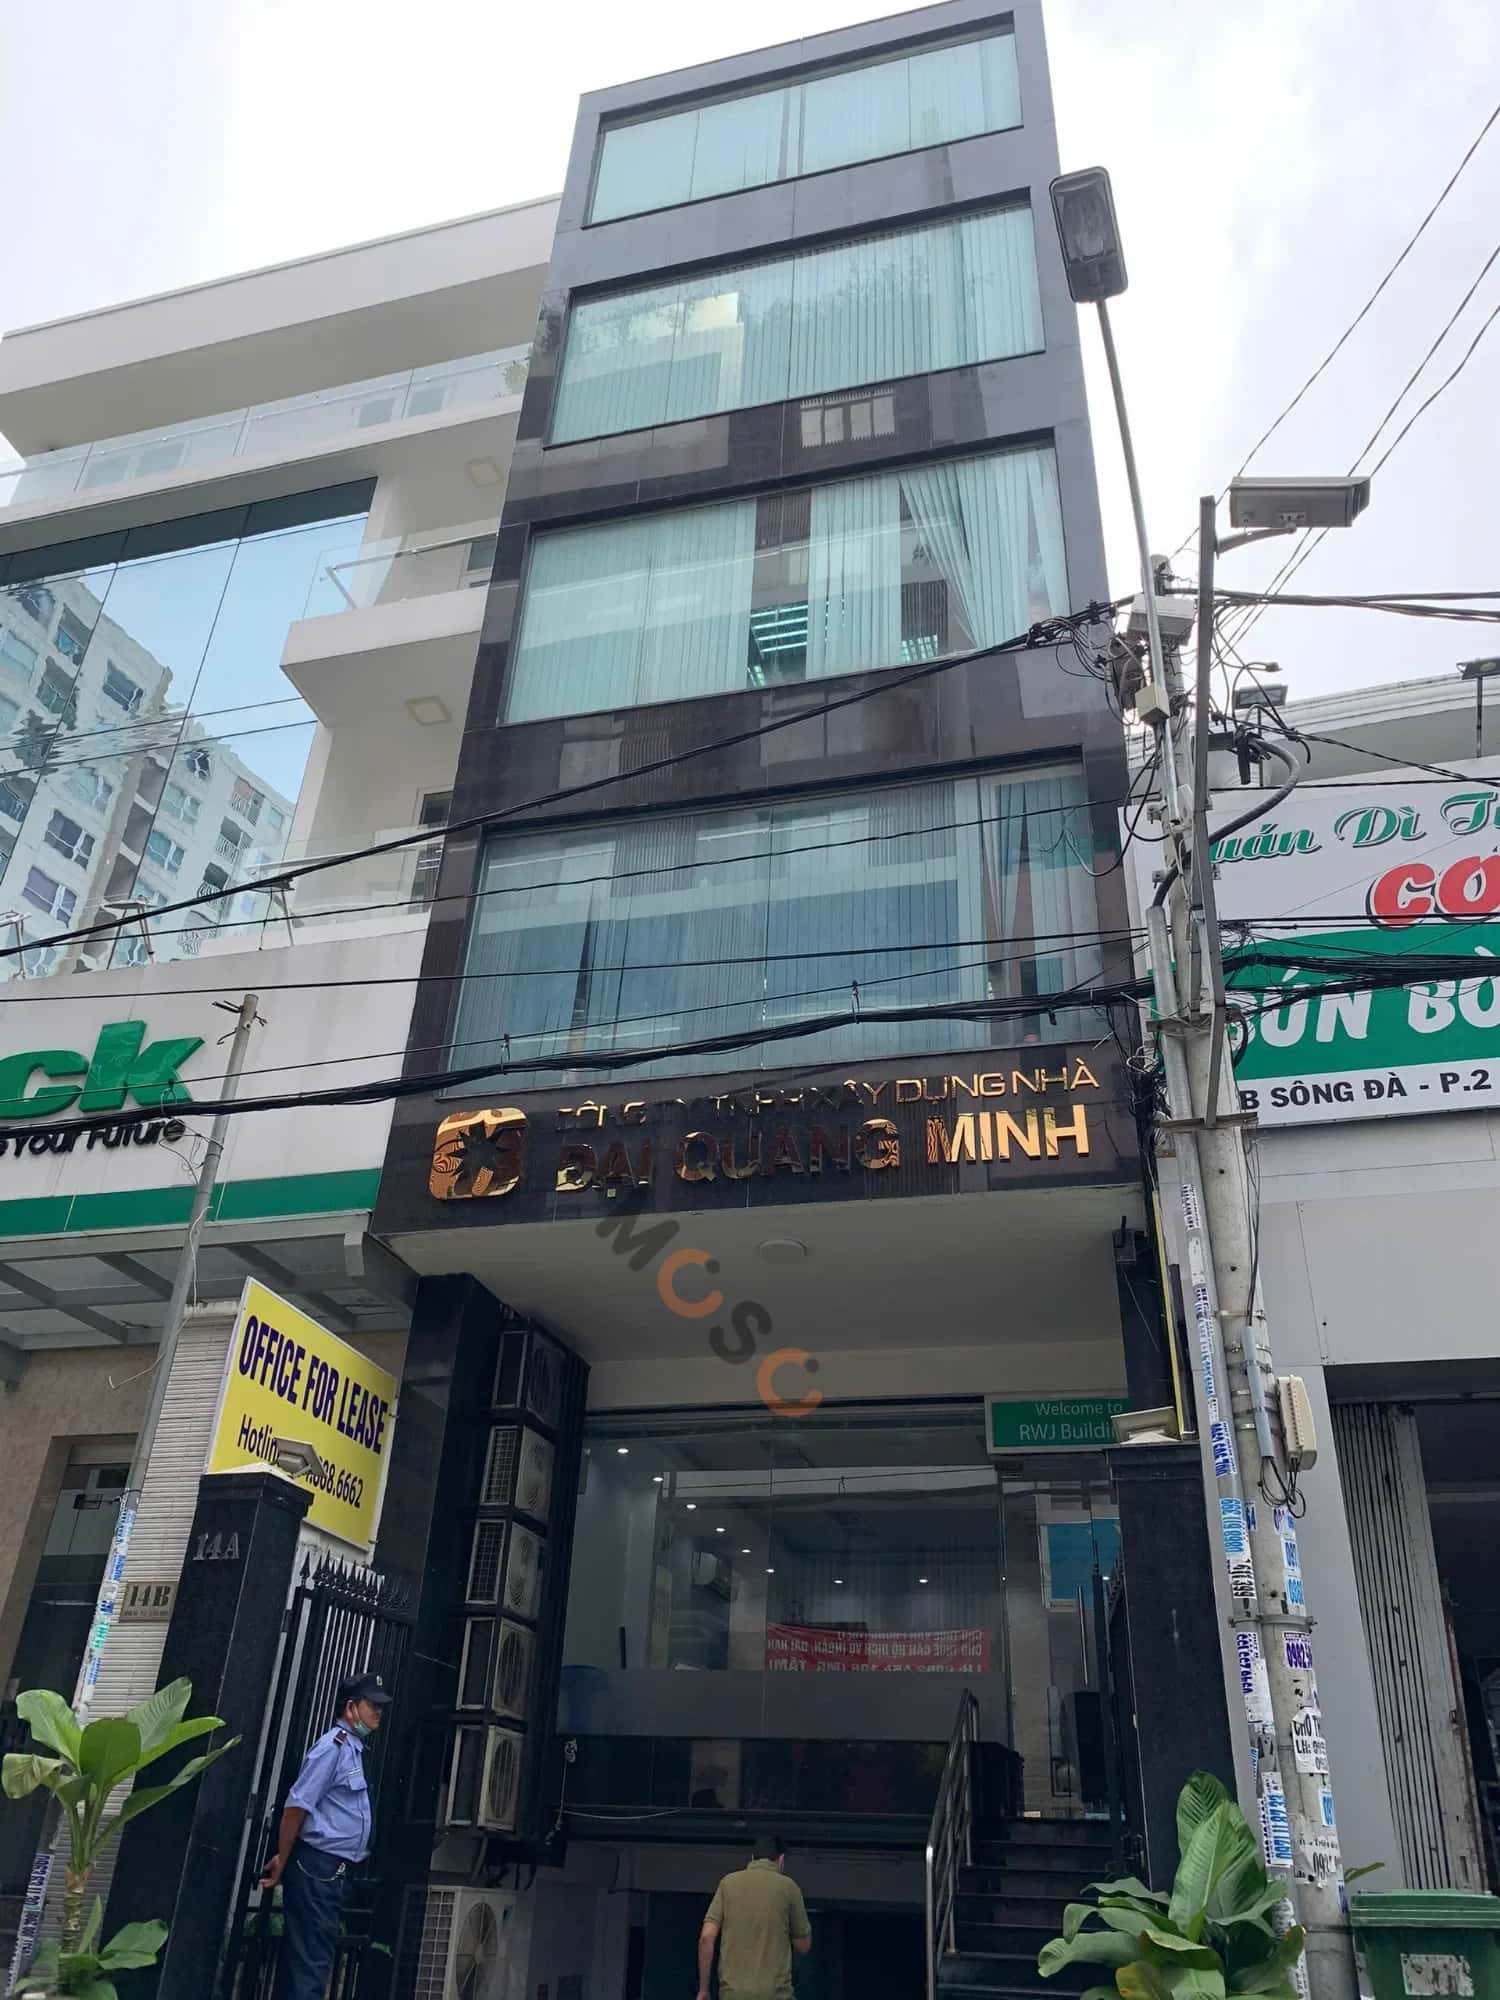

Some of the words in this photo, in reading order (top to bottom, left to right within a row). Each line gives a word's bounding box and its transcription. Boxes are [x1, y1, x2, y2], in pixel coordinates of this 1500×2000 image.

[1210, 823, 1321, 864] uán
[1333, 805, 1425, 848] Dì
[1440, 791, 1500, 836] T
[1012, 1057, 1100, 1095] NHÀ
[1271, 1080, 1354, 1108] SÔNG
[1363, 1071, 1408, 1101] ĐÀ
[1440, 1069, 1492, 1093] P.2
[555, 1137, 652, 1198] ĐẠI
[674, 1117, 901, 1183] QUANG
[926, 1103, 1090, 1164] MINH
[239, 1315, 306, 1404] OFFICE
[302, 1356, 339, 1427] FOR
[336, 1376, 389, 1455] LEASE
[1034, 1401, 1104, 1417] Welcome
[1107, 1402, 1124, 1414] to
[237, 1413, 280, 1463] Hotlin
[1019, 1423, 1056, 1441] RWJ
[1061, 1421, 1117, 1440] Buildi
[192, 1532, 240, 1561] 14A
[129, 1585, 171, 1607] 14B
